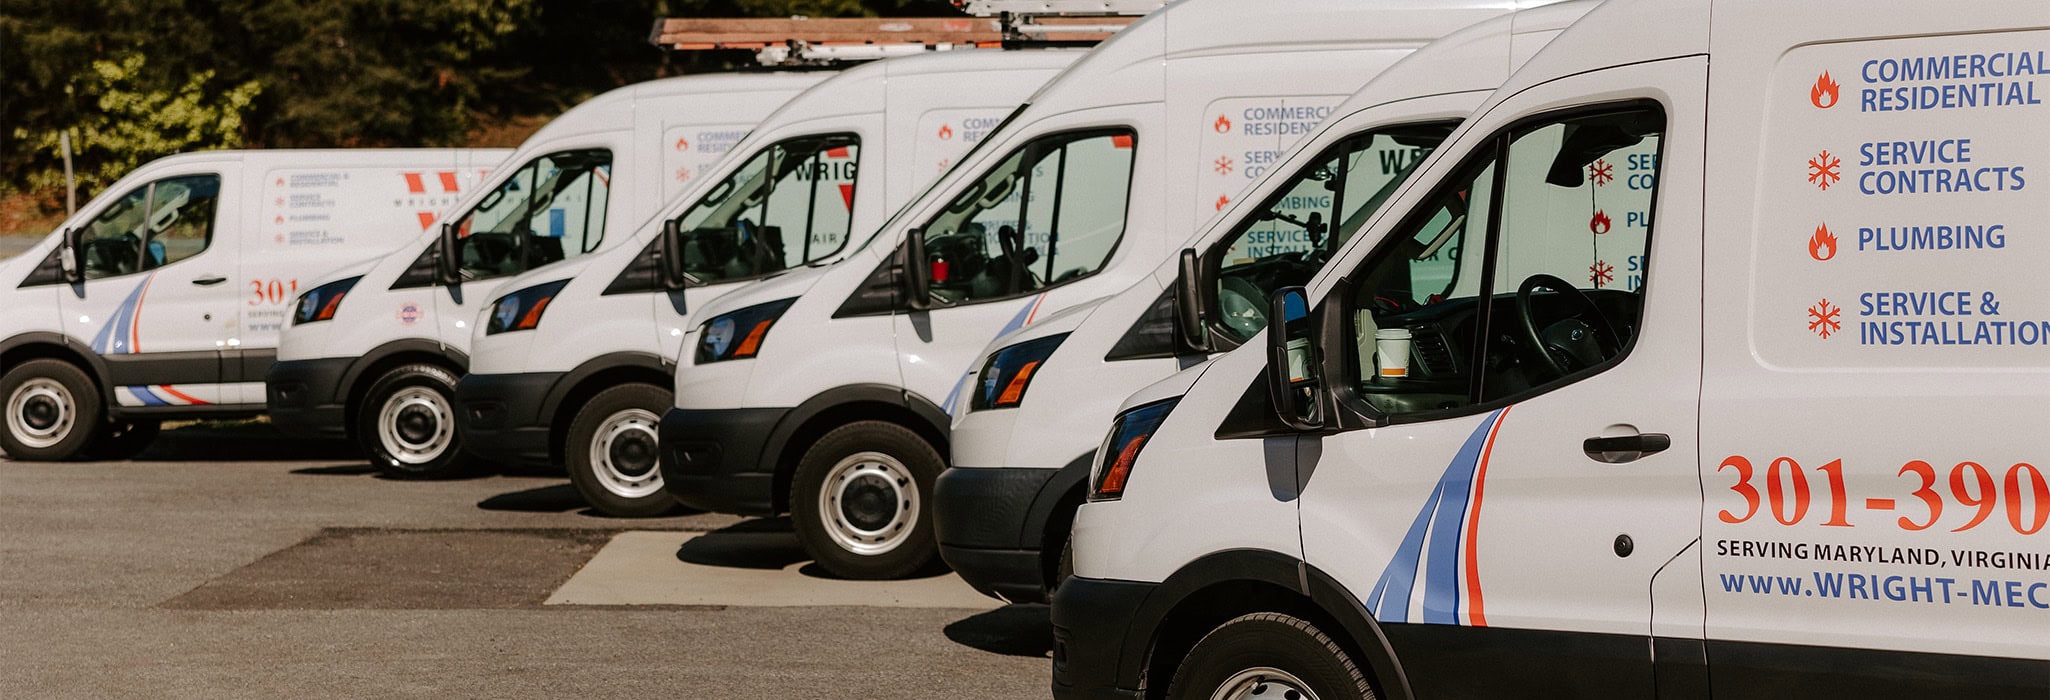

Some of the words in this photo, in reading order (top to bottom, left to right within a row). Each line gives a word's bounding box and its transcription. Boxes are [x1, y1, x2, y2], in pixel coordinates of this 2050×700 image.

[1861, 51, 2050, 84] COMMERCIAL
[1861, 81, 2042, 112] RESIDENTIAL
[1860, 139, 1971, 166] SERVICE
[1859, 166, 2026, 195] CONTRACTS
[1858, 224, 2006, 251] PLUMBING
[1860, 291, 1972, 316] SERVICE
[1979, 291, 2001, 316] &
[1717, 455, 2050, 535] 301-390
[1717, 540, 1808, 560] SERVING
[1814, 543, 1947, 569] MARYLAND,
